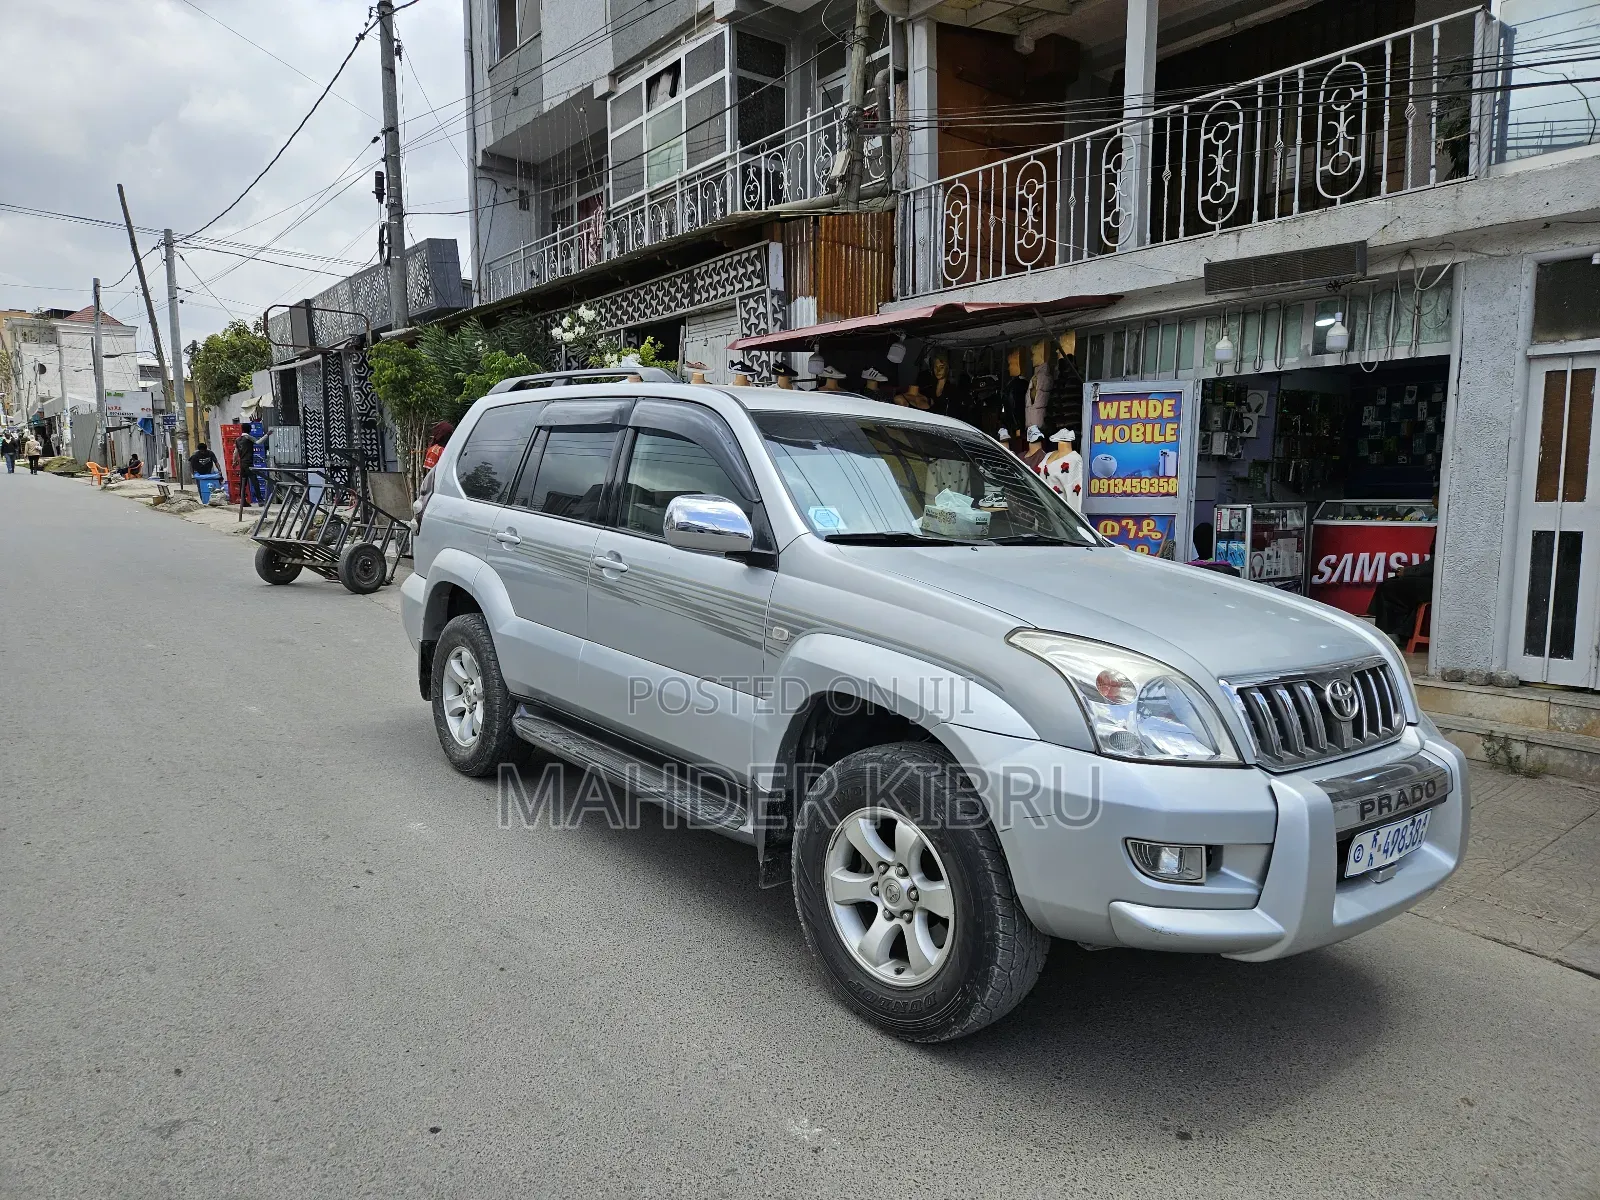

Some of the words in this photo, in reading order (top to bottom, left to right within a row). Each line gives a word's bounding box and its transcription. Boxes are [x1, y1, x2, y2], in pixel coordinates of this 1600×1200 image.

[1098, 399, 1176, 420] WENDE
[1093, 422, 1178, 444] MOBILE
[1090, 477, 1178, 495] 0913459358
[1099, 518, 1163, 540] ወንዴ
[1360, 778, 1437, 822] PRADO
[847, 979, 937, 1014] DUNLOP
